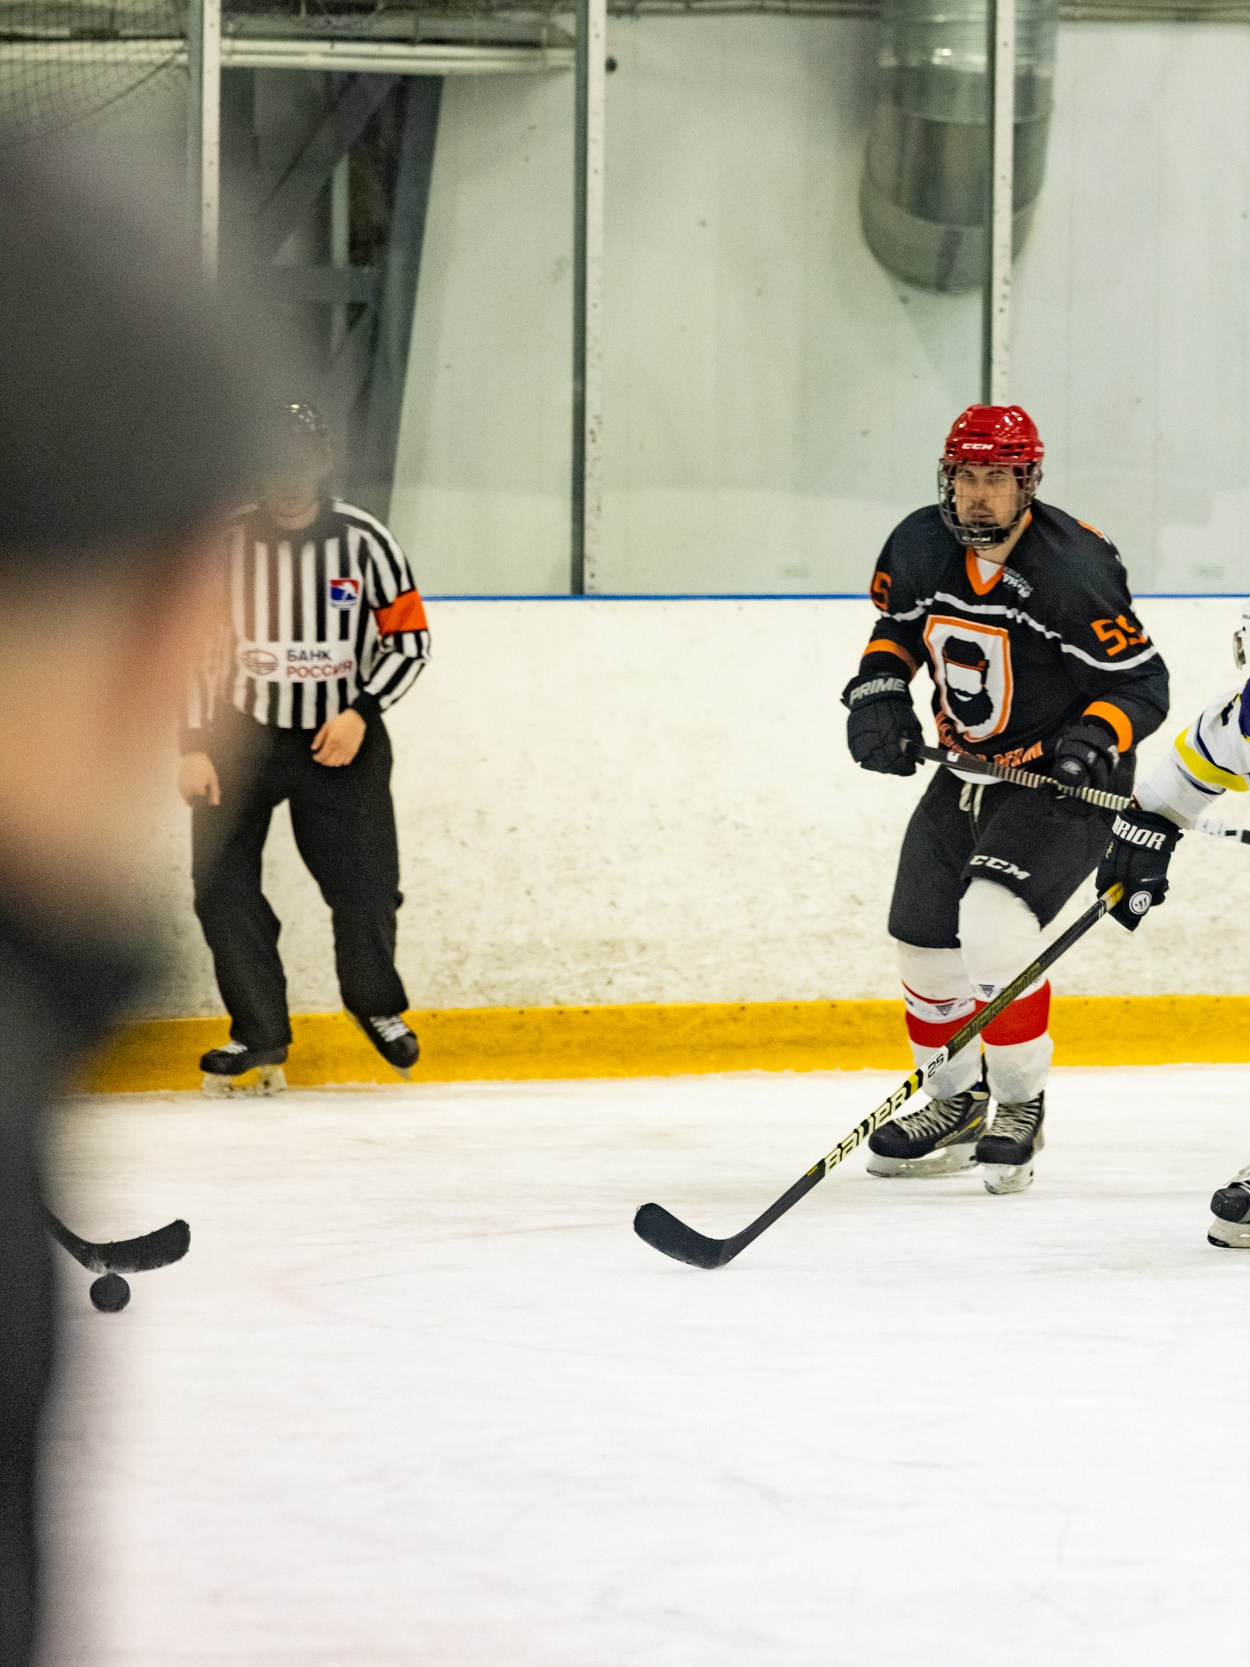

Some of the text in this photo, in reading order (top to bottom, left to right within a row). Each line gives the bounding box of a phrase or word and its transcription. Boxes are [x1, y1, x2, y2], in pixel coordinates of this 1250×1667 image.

[961, 442, 994, 451] CCM
[286, 649, 332, 662] БАНК
[286, 660, 353, 679] РОССИЯ
[849, 677, 907, 706] PRIME
[968, 854, 1032, 881] CCM
[823, 1085, 909, 1175] BAUER
